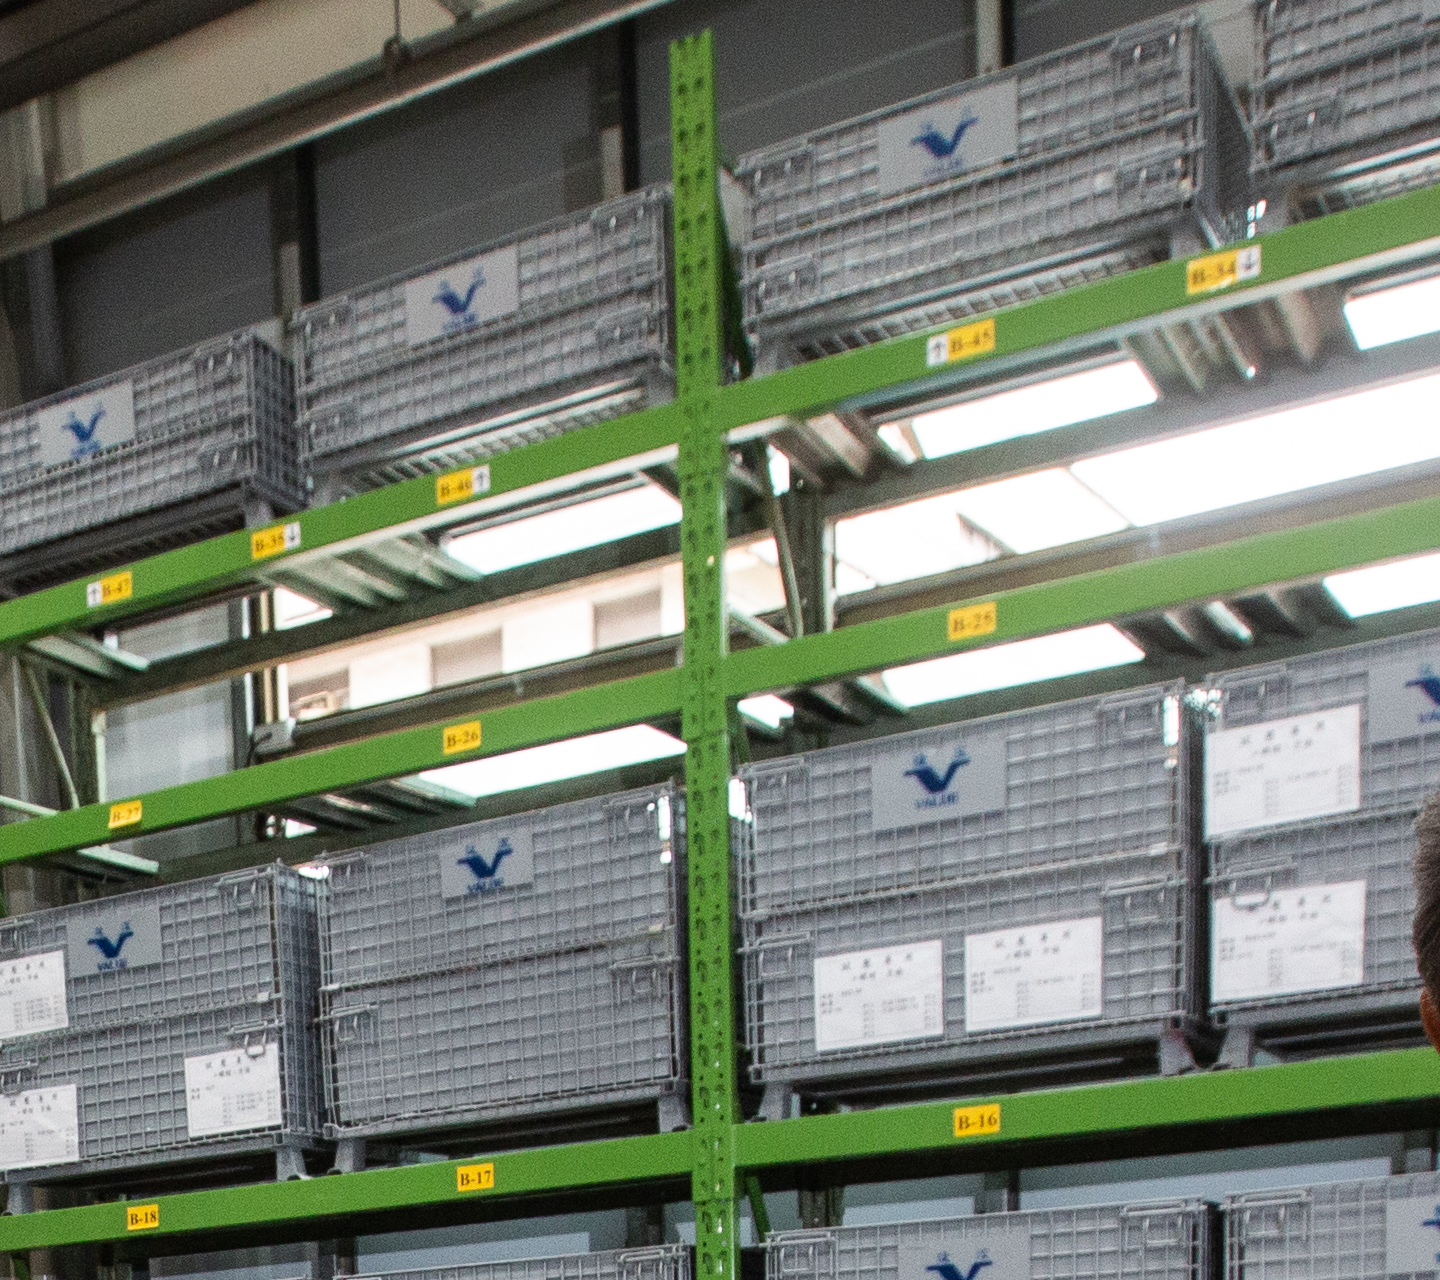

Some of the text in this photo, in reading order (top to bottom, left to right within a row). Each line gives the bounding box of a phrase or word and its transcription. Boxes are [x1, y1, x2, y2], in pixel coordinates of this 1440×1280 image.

[448, 730, 480, 750] B-26
[958, 1113, 998, 1131] B-16
[460, 1170, 491, 1187] B-17
[130, 1211, 157, 1226] B-18
